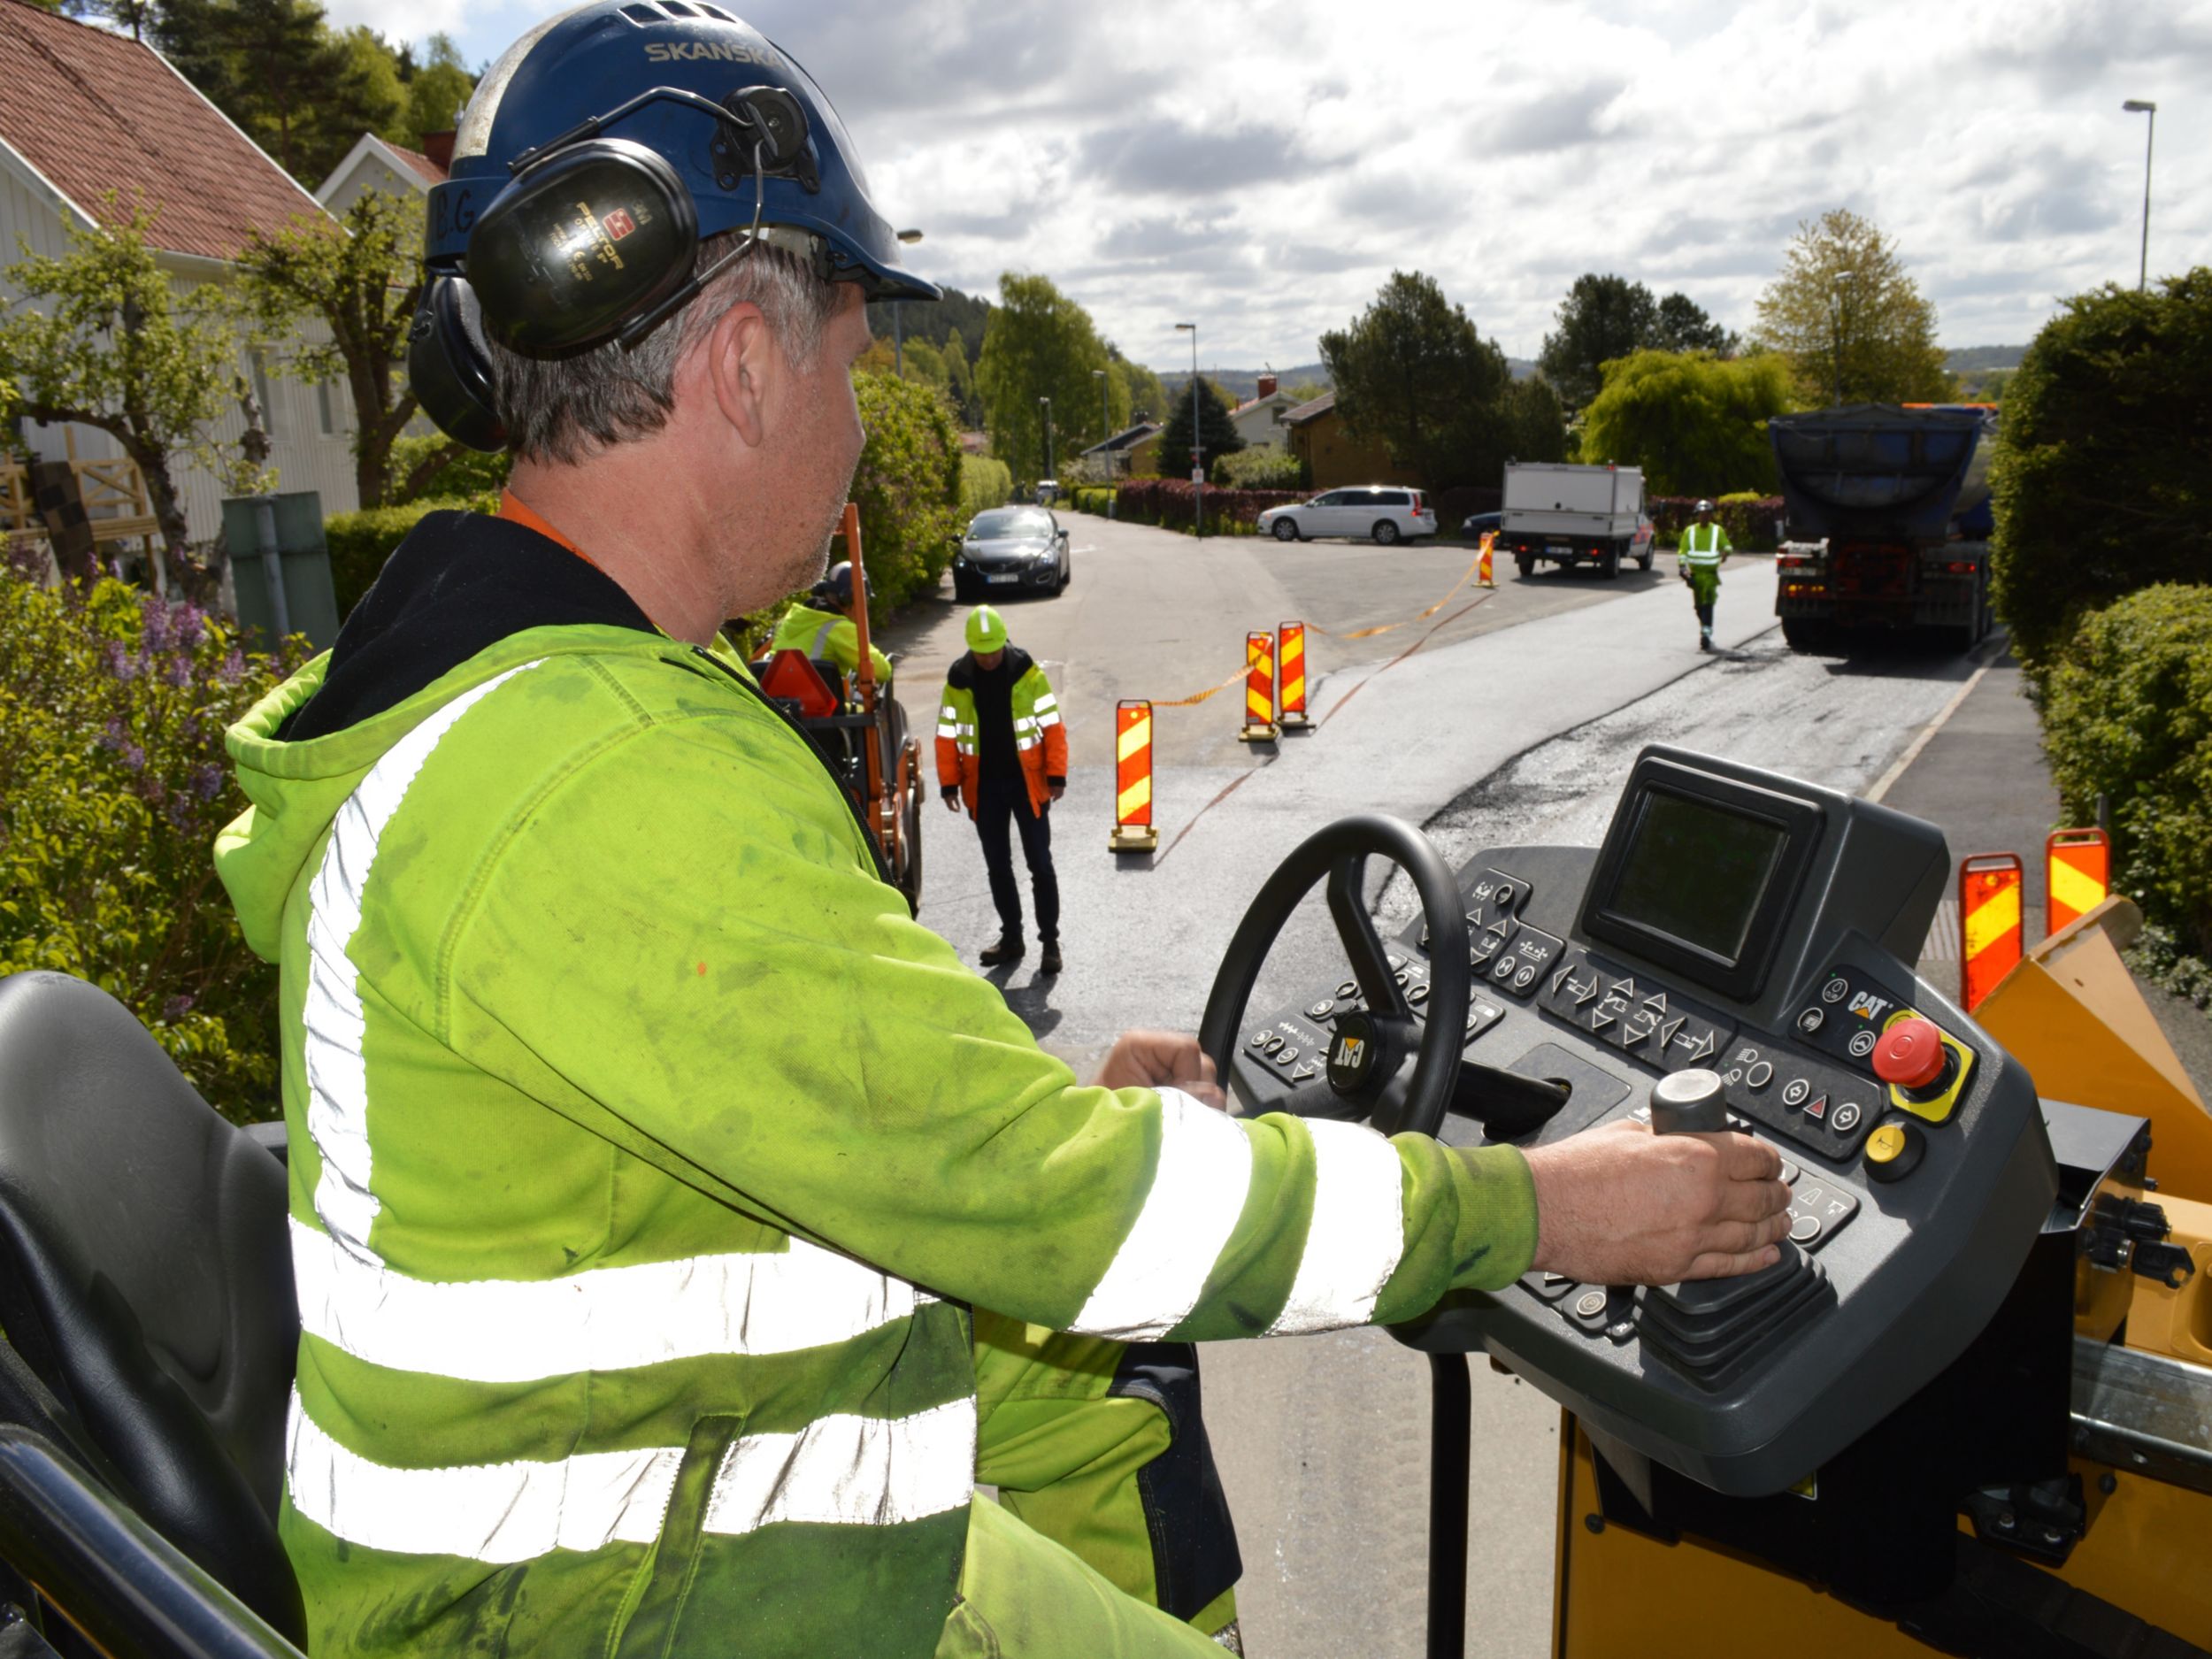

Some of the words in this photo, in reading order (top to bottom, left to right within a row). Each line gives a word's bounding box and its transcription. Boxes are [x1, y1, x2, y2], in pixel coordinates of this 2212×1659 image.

[644, 42, 787, 71] SKANSKA
[632, 200, 653, 225] 3M
[576, 202, 624, 269] PELTOR
[1847, 991, 1888, 1020] CAT
[1334, 1037, 1364, 1068] CAT
